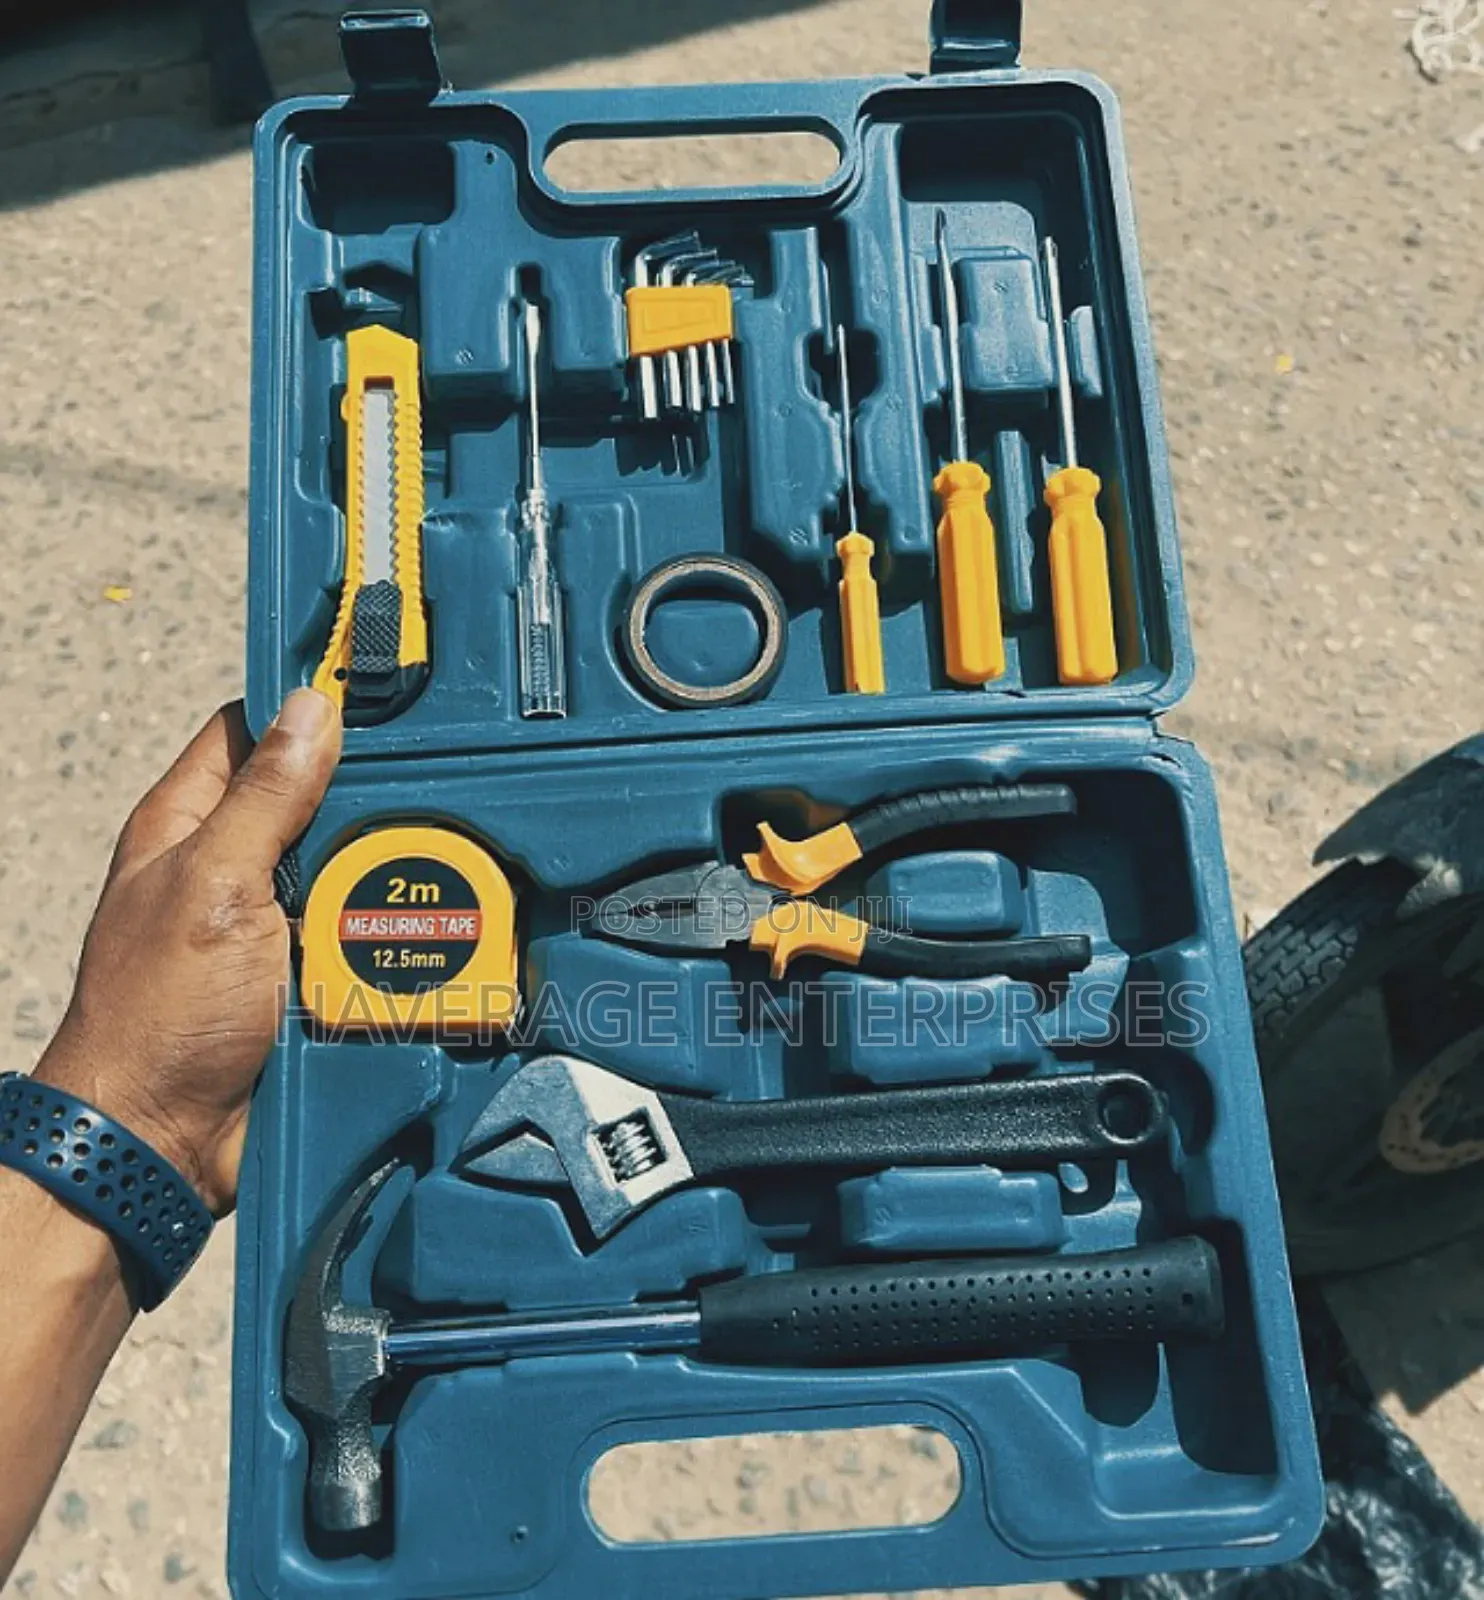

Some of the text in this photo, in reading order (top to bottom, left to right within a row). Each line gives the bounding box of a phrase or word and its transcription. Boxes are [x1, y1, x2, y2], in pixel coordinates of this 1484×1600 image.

[387, 878, 441, 903] 2m
[345, 916, 476, 936] MEASURING TAPE
[372, 949, 447, 969] 12.5mm
